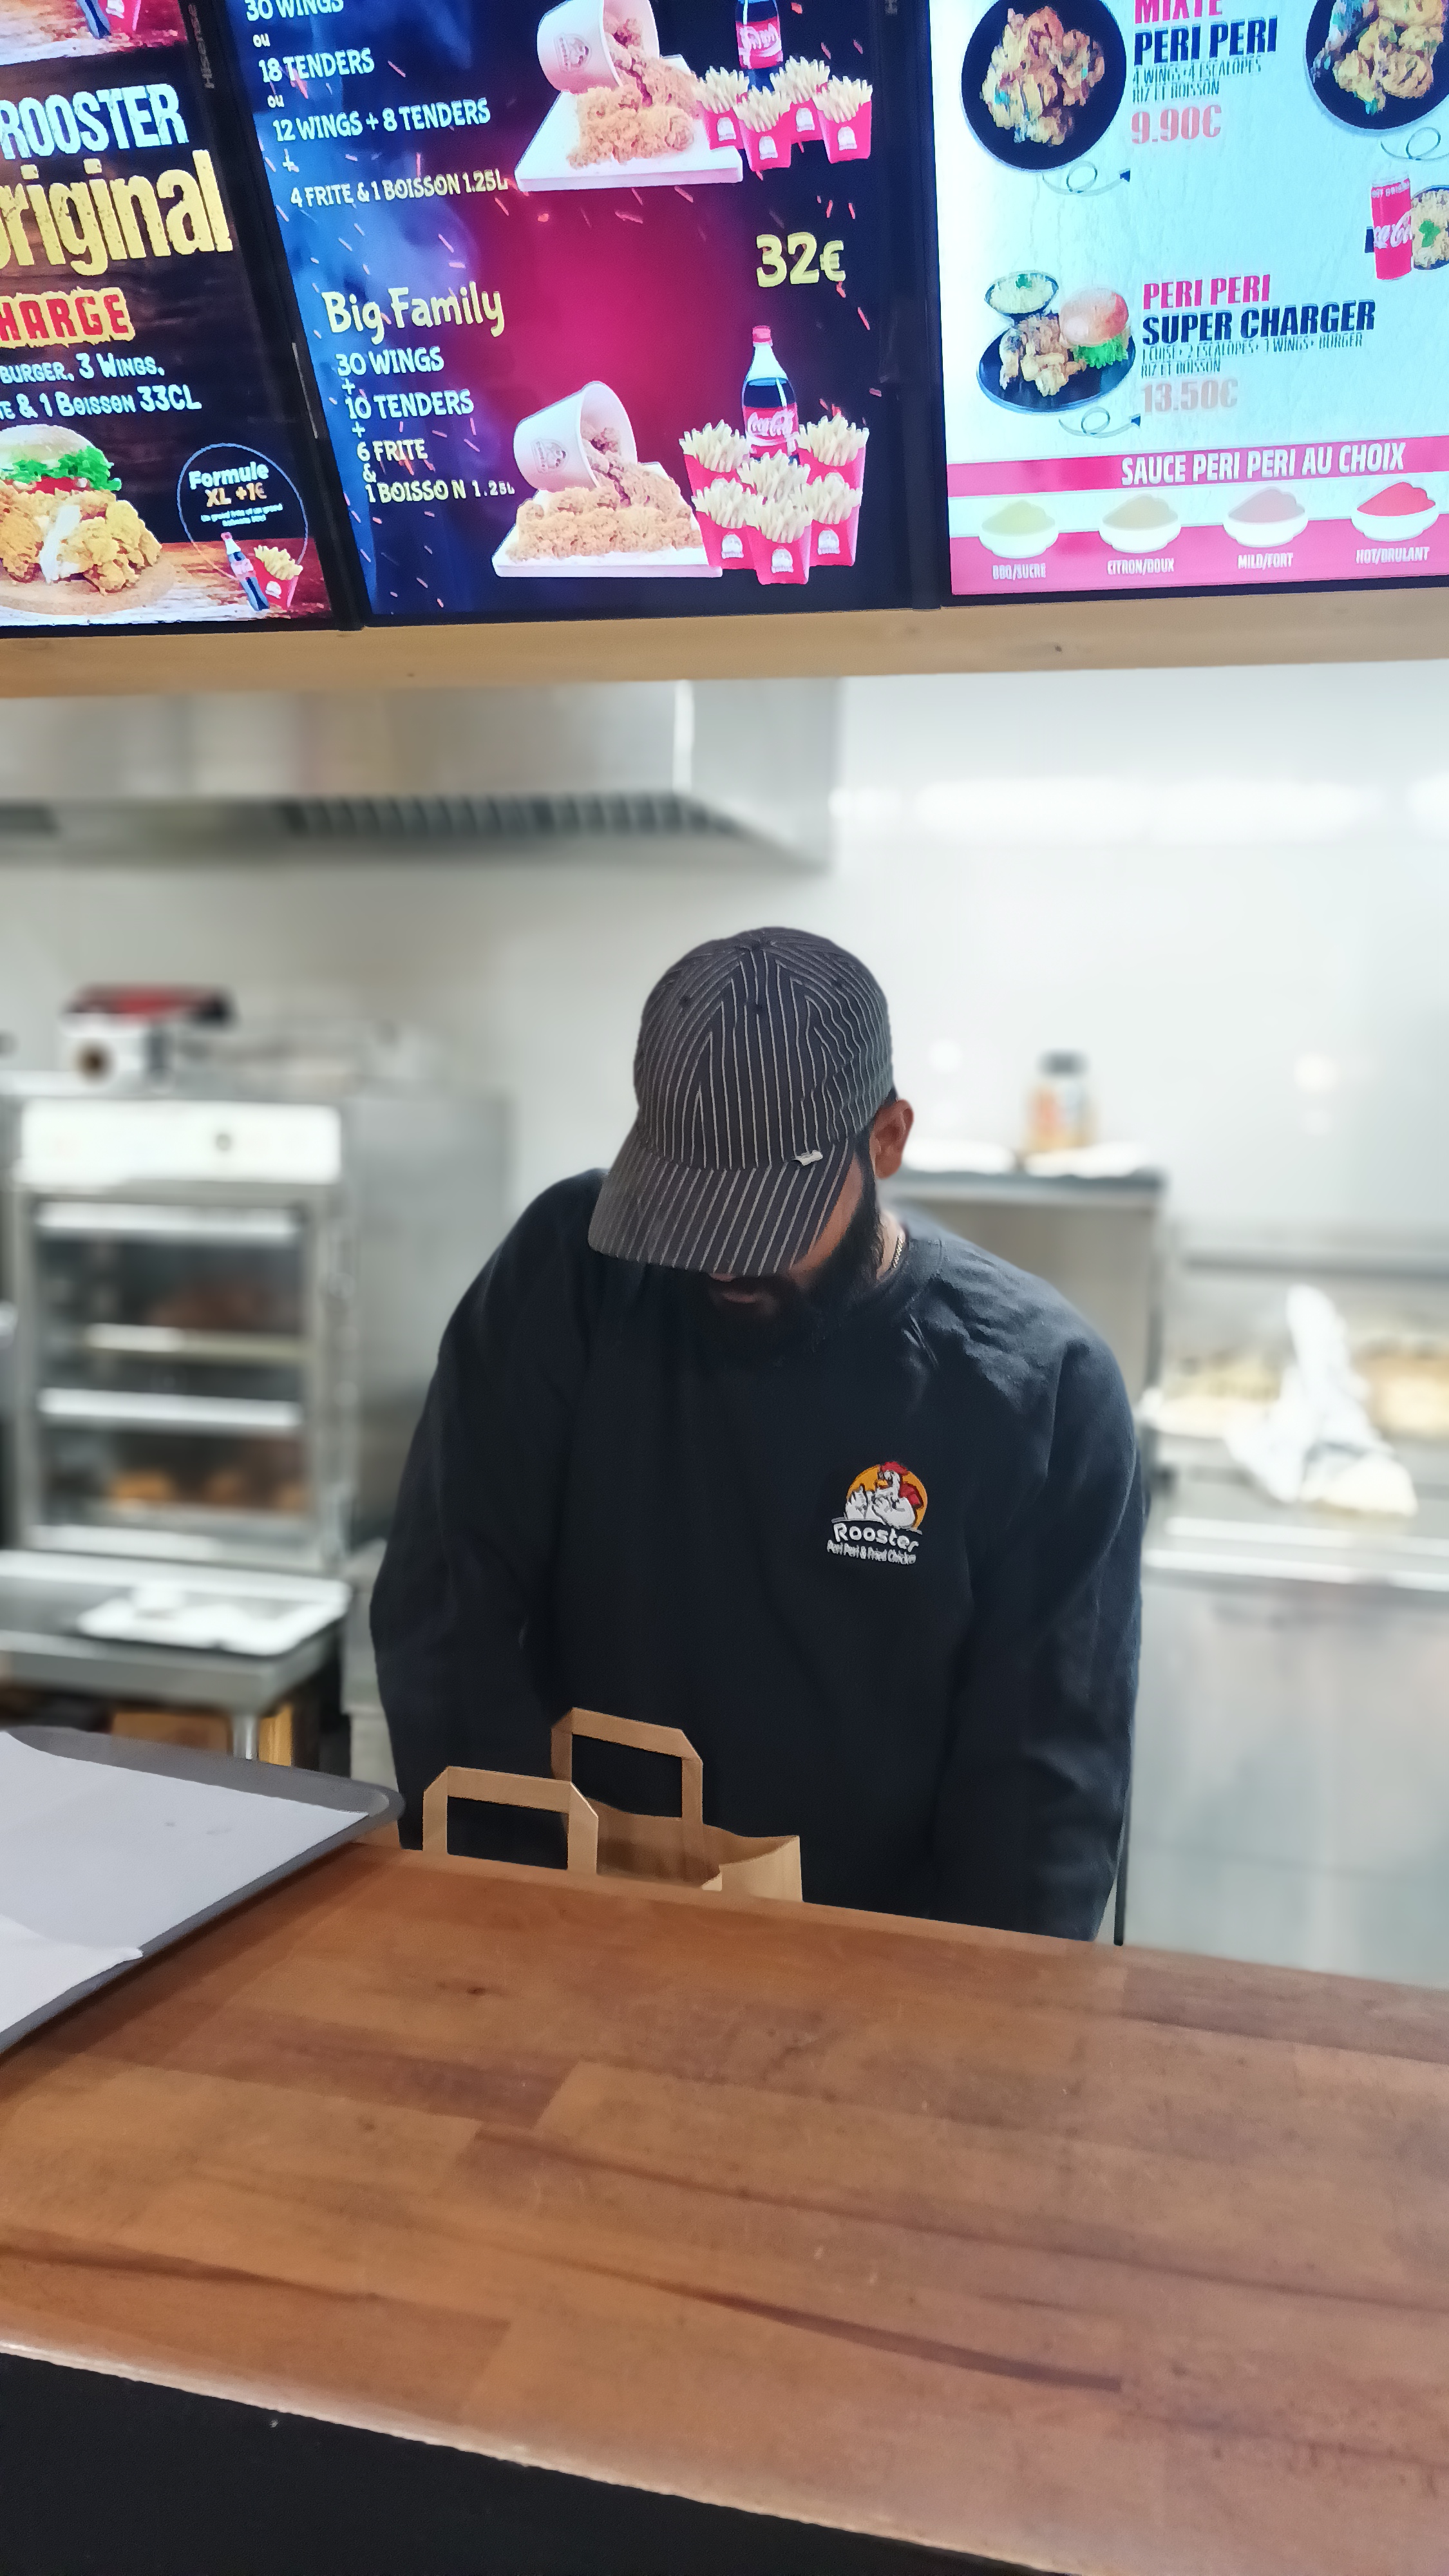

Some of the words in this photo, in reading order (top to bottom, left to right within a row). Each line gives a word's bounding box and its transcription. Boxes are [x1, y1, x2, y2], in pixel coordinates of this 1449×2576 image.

[245, 0, 273, 21] 30
[1134, 24, 1200, 66] PERI
[1209, 15, 1277, 58] PERI
[259, 57, 283, 82] 18
[283, 47, 375, 81] TENDERS
[0, 84, 189, 159] ROOSTER
[273, 119, 296, 142] 12
[296, 111, 363, 140] WINGS
[366, 112, 379, 130] +
[382, 108, 397, 131] 8
[399, 97, 491, 131] TENDERS
[291, 187, 303, 207] 4
[305, 184, 354, 207] FRITE
[357, 182, 370, 202] &
[371, 181, 381, 200] 1
[382, 173, 461, 200] BOISSON
[462, 168, 508, 193] 1.25L
[0, 149, 232, 276] riginal
[756, 232, 846, 287] 32€
[1144, 279, 1202, 310] PERI
[1211, 274, 1270, 305] PERI
[322, 292, 384, 345] Big
[388, 281, 505, 337] Family
[1143, 310, 1232, 345] SUPER
[1240, 299, 1375, 338] CHARGER
[76, 352, 94, 379] 3
[336, 353, 366, 376] 30
[368, 346, 444, 375] WINGS
[16, 393, 38, 418] &
[39, 393, 53, 417] 1
[137, 384, 202, 412] 33CL
[342, 378, 355, 394] +
[345, 396, 372, 419] 10
[374, 388, 474, 419] TENDERS
[352, 421, 365, 438] +
[357, 441, 370, 461] 6
[372, 438, 428, 461] FRITE
[1122, 455, 1186, 486] SAUCE
[1193, 452, 1240, 482] PERI
[1247, 449, 1295, 478] PERI
[1302, 446, 1332, 475] AU
[1339, 442, 1405, 473] CHOIX
[189, 461, 269, 489] Formule
[363, 463, 376, 482] &
[205, 488, 232, 507] XL
[365, 484, 375, 502] 1
[833, 1522, 919, 1552] Rooster
